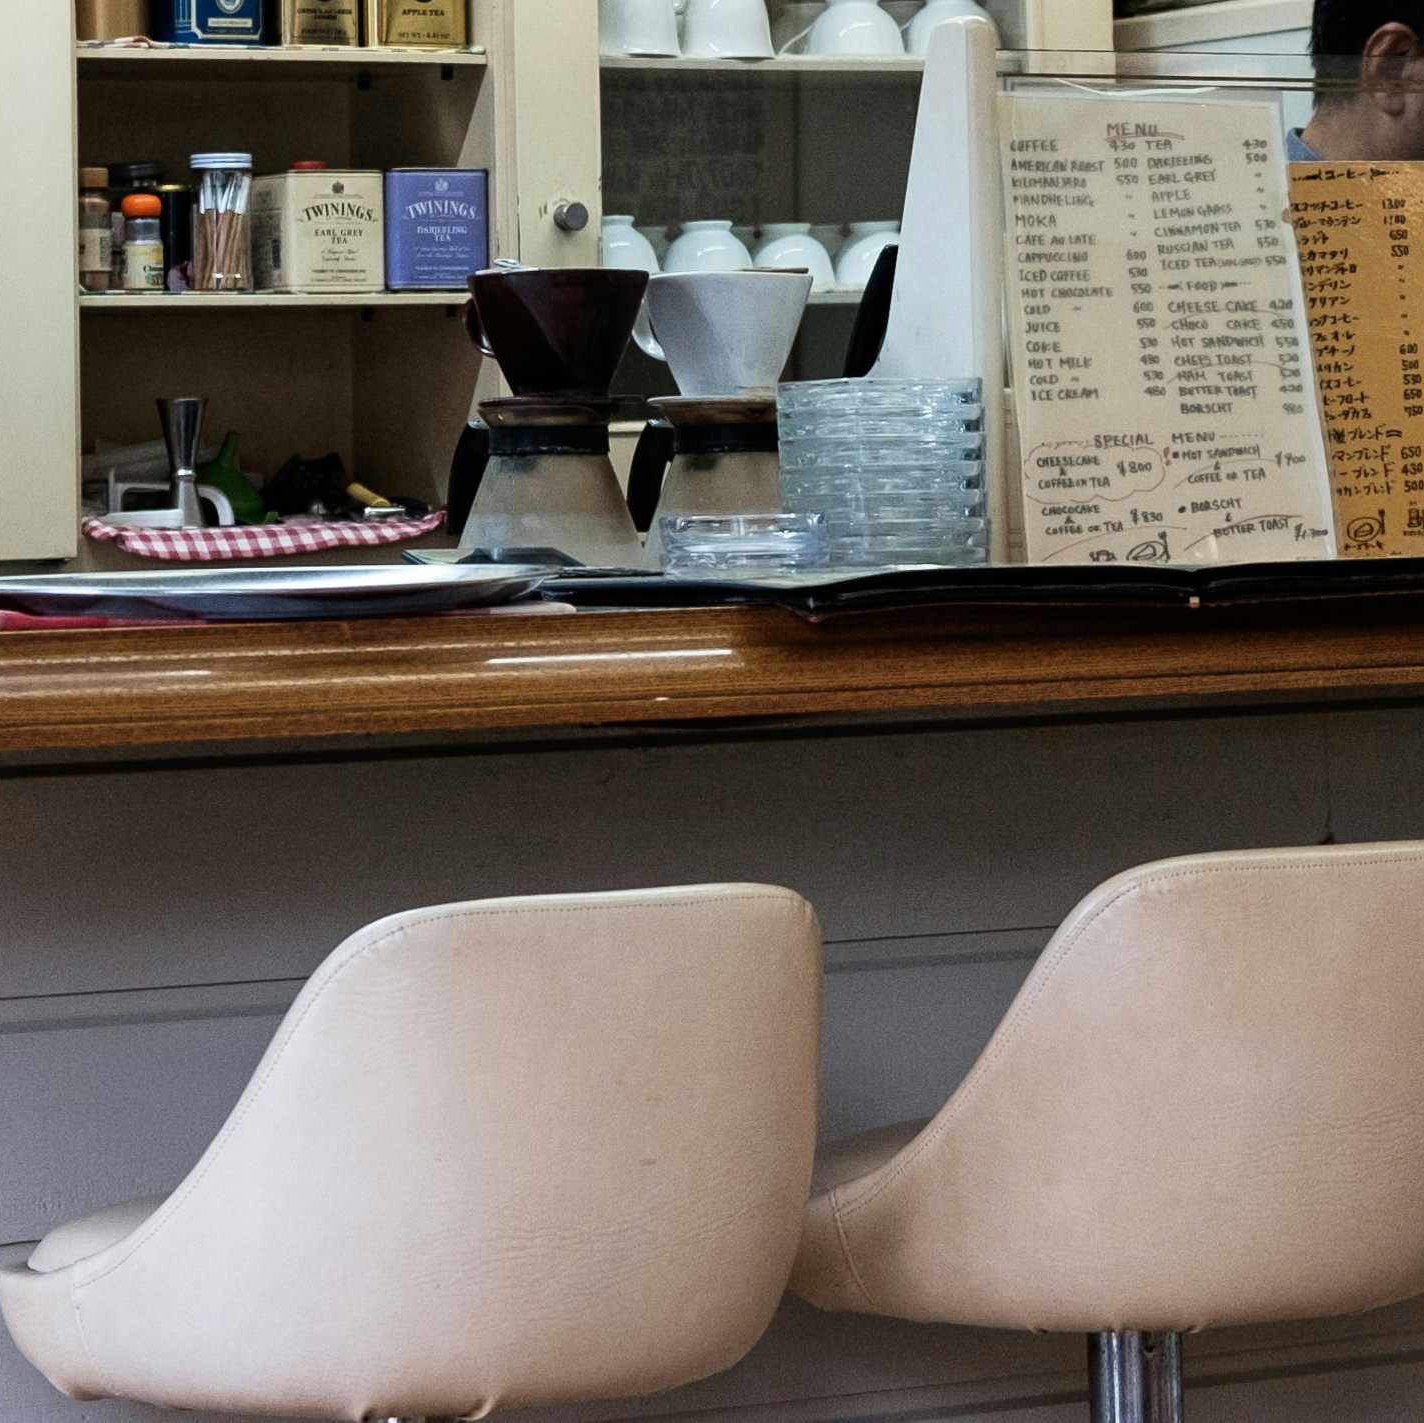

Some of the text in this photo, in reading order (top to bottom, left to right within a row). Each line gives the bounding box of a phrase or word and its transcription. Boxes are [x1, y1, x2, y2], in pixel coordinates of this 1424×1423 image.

[427, 9, 445, 17] TEA
[1106, 123, 1158, 137] MENU
[1010, 139, 1058, 152] COFFEE
[1145, 139, 1173, 151] TEA
[1011, 158, 1067, 173] AMERICAN
[1114, 157, 1138, 169] 500
[1245, 153, 1267, 164] 500
[1148, 168, 1216, 185] EARL GREY
[1151, 188, 1191, 202] APPLE
[303, 202, 374, 222] TWININGS
[405, 200, 477, 219] TWININGS
[1015, 214, 1057, 227] MOKA
[1220, 221, 1241, 233] TEA
[314, 229, 364, 237] EARL GREY
[417, 226, 468, 236] DARJEELING
[331, 236, 348, 244] TEA
[434, 234, 451, 242] TEA
[1016, 234, 1045, 245] CAFE
[1157, 239, 1208, 255] RUSSIAN
[1211, 238, 1235, 249] TEA
[1161, 258, 1190, 271] ICED
[1194, 257, 1217, 268] TEA
[1019, 269, 1047, 281] ICED
[1050, 269, 1090, 282] COFFEE
[1021, 288, 1044, 298] HOT
[1050, 286, 1113, 298] CHOCOLATE
[1023, 304, 1051, 315] COLD
[1167, 299, 1218, 314] CHEESE
[1224, 299, 1257, 313] CAKE
[1025, 322, 1060, 334] JUICE
[1226, 318, 1262, 330] CAKE
[1026, 340, 1062, 353] COKE
[1171, 334, 1195, 349] HOT
[1028, 357, 1092, 369] HOT MILK
[1215, 353, 1252, 366] TOAST
[1401, 359, 1419, 371] 500
[1029, 374, 1058, 385] COLD
[1217, 370, 1253, 382] TOAST
[1030, 387, 1099, 401] ICE CREAM
[1180, 402, 1233, 415] BORSCHT
[1093, 431, 1215, 449] SPECIAL MENU
[1206, 444, 1260, 459] SANDWICH
[1400, 445, 1422, 459] 650
[1401, 462, 1423, 476] 430
[1089, 476, 1111, 489] TEA
[1187, 468, 1267, 484] COFFEE TEA
[1404, 479, 1424, 493] 500
[1190, 497, 1242, 513] BORSCHT
[1045, 521, 1124, 536] COFFEE TEA
[1259, 518, 1290, 531] TOAST
